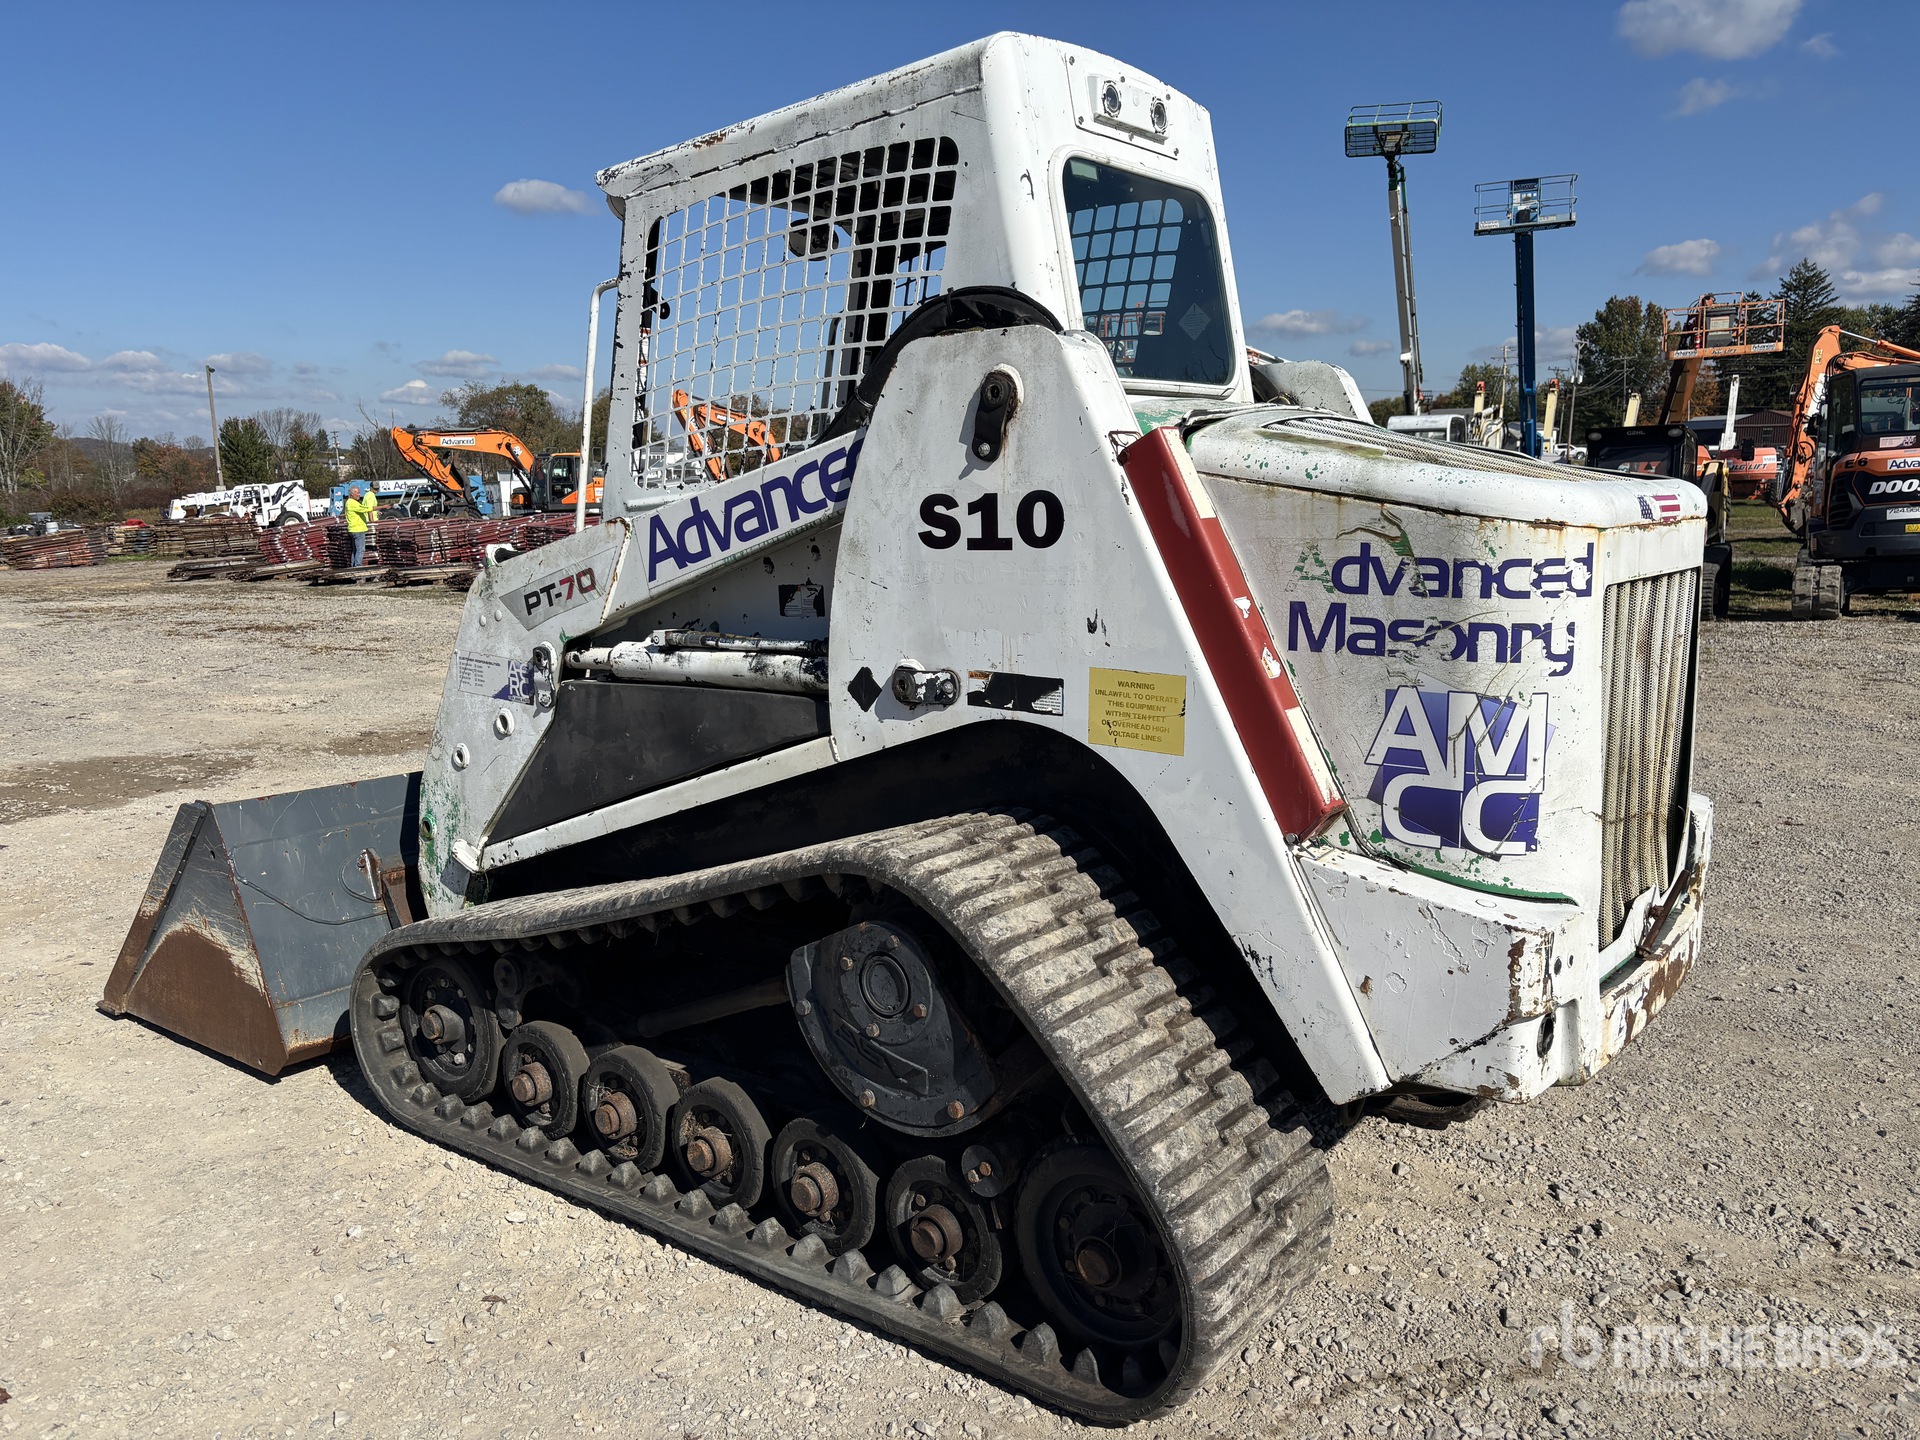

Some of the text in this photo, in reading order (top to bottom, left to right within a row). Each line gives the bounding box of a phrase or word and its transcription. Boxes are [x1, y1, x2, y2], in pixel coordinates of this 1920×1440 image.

[917, 489, 1065, 551] S10
[1285, 542, 1595, 599] Advanced
[524, 567, 596, 616] PT-70
[1287, 600, 1576, 678] Masonry
[1117, 680, 1156, 691] WARNING
[1094, 688, 1179, 704] UNLAWFUL TO OPERATE
[1107, 699, 1167, 713] THIS EQUIPMENT
[1105, 709, 1166, 723] WITHIN TEN FEET
[1112, 720, 1151, 731] OVERHEAD
[1152, 725, 1170, 734] HIGH
[1107, 729, 1163, 743] VOLTAGE LINES
